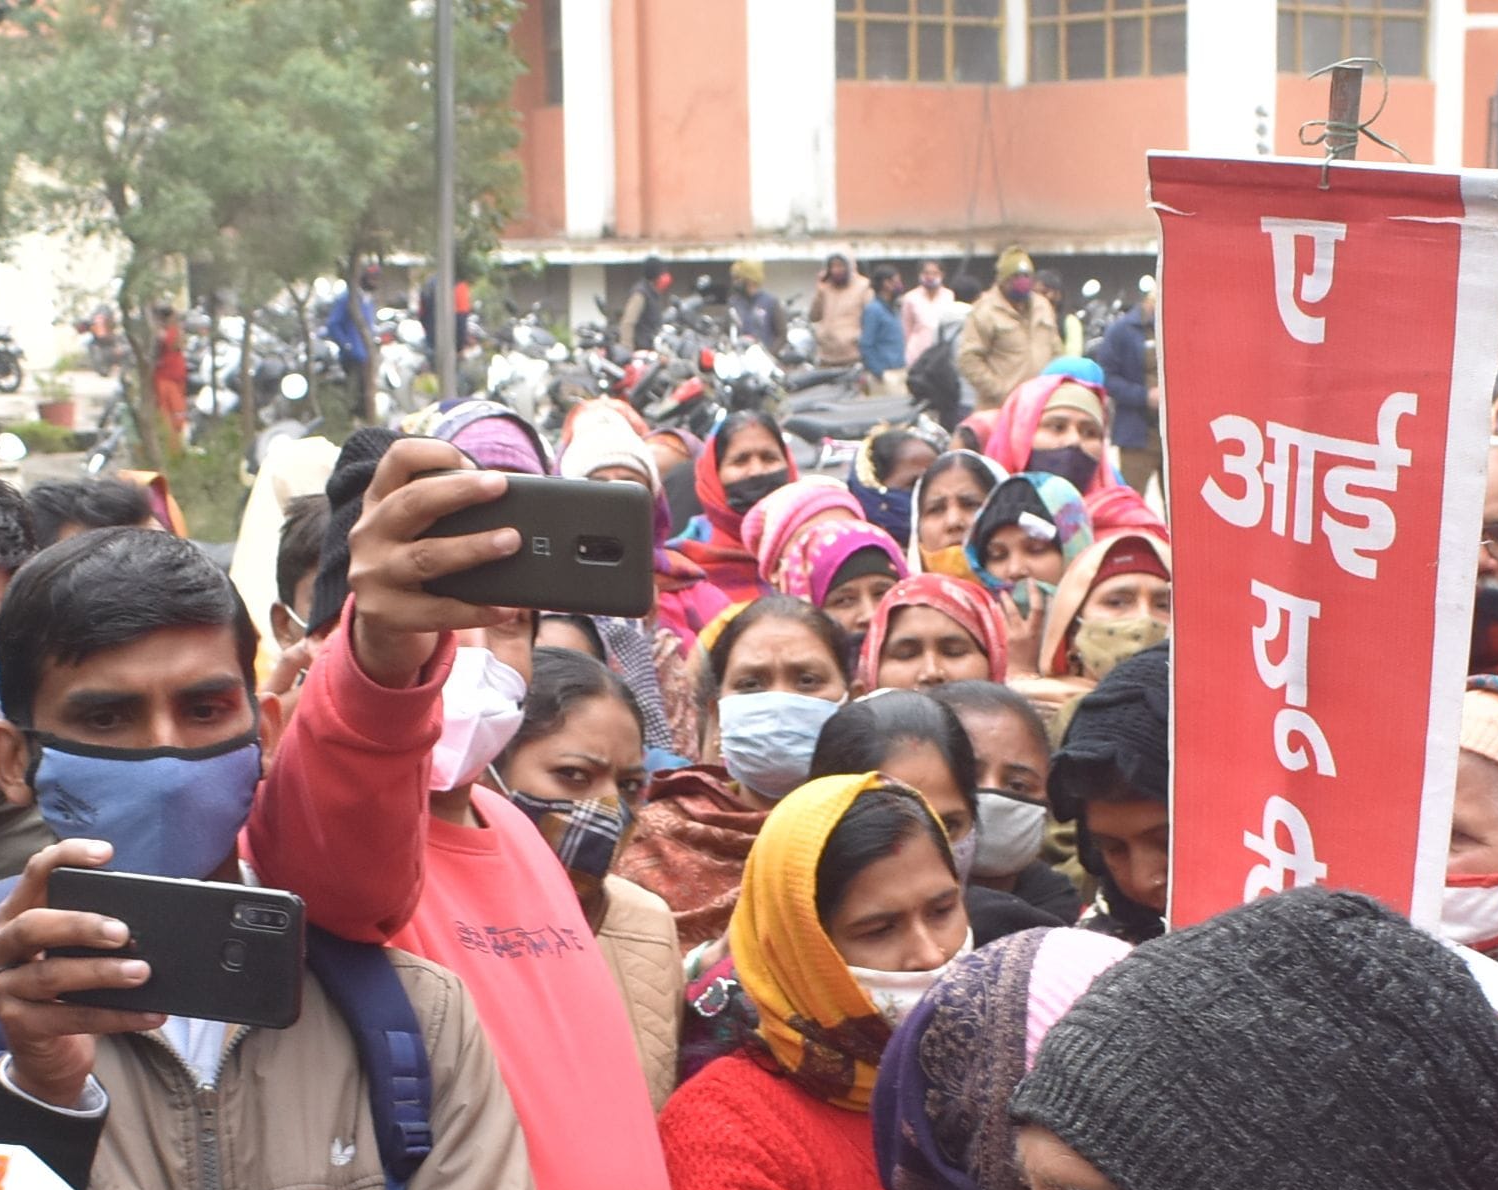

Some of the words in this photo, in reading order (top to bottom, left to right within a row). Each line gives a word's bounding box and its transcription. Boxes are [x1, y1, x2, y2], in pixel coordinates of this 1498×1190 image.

[1260, 216, 1347, 345] ए
[1200, 391, 1418, 580] आई
[1250, 578, 1337, 778] यू
